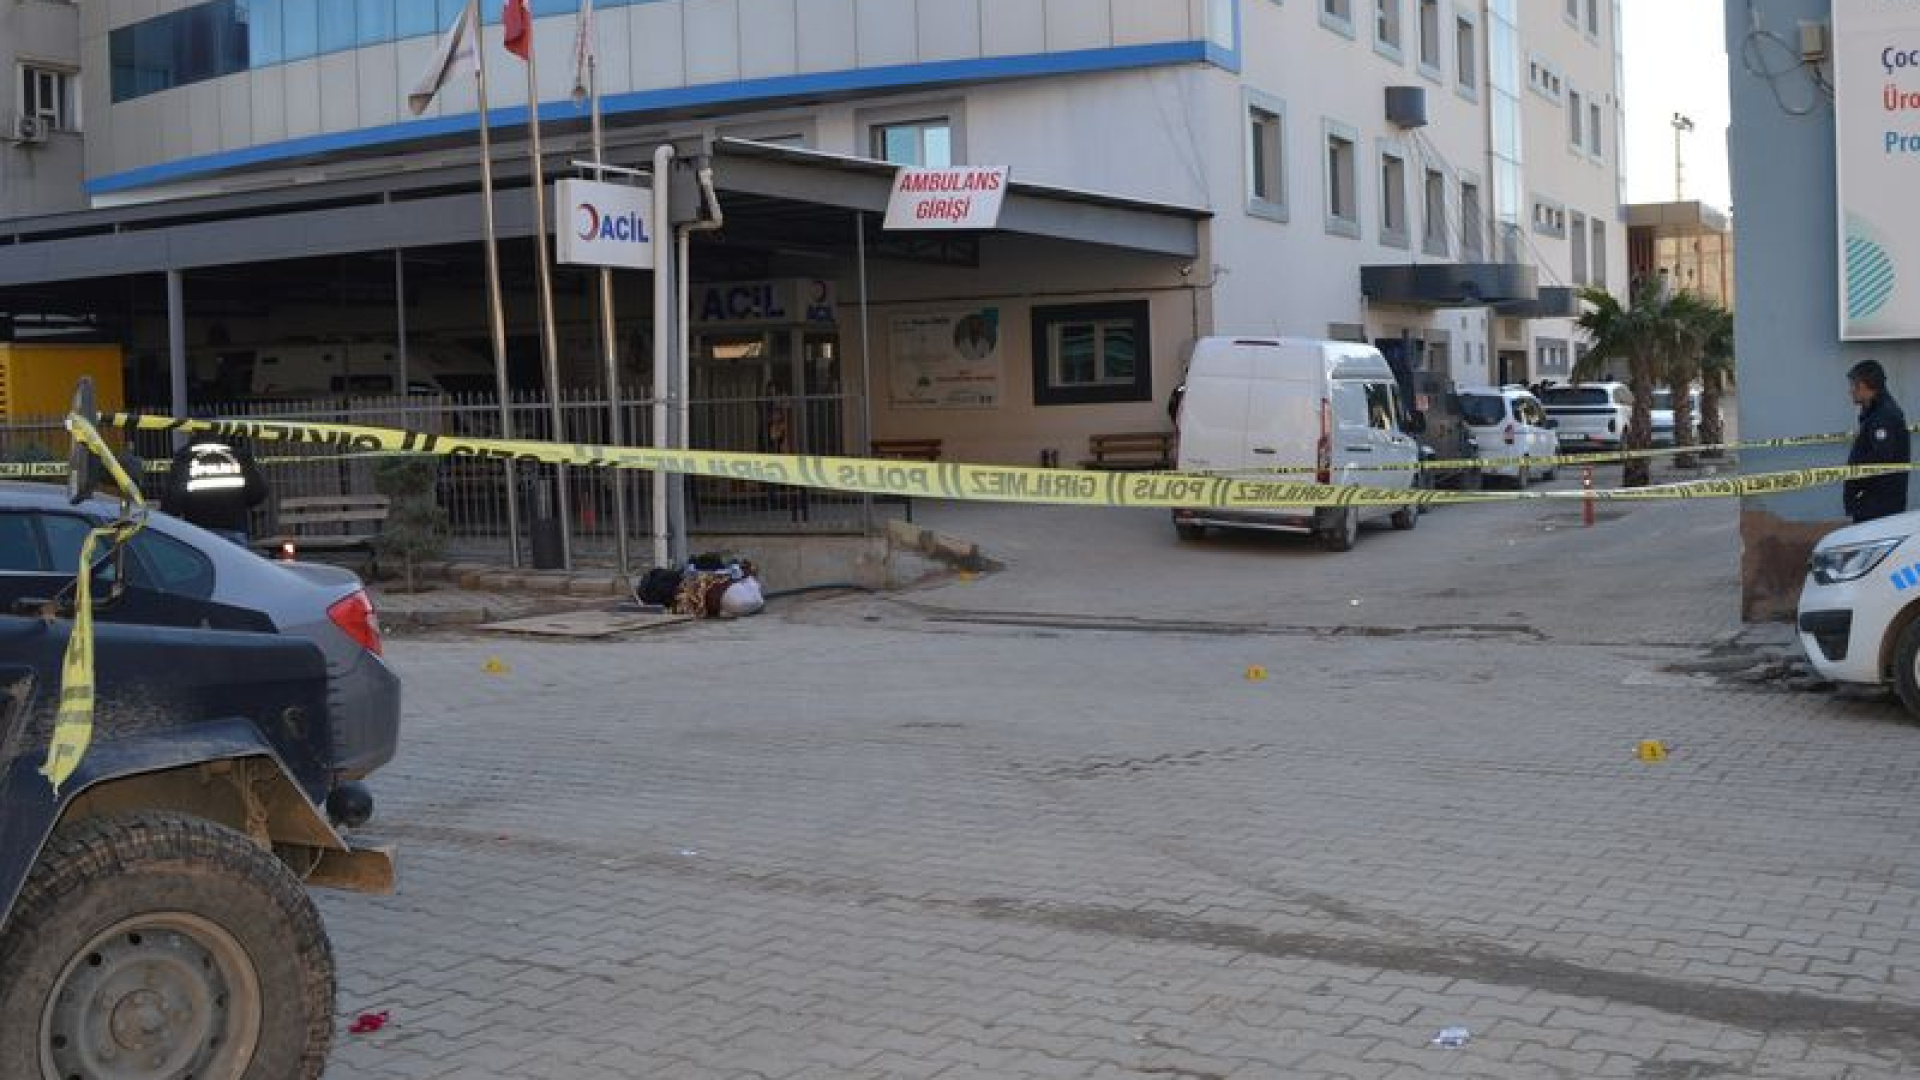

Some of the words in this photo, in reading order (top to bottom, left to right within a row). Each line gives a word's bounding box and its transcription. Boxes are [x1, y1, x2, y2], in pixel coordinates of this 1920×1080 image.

[1881, 46, 1920, 75] Çoc
[1883, 83, 1920, 111] Üro
[900, 172, 1001, 193] AMBULANS
[916, 197, 971, 223] GİRİŞİ
[600, 210, 649, 244] ACİL
